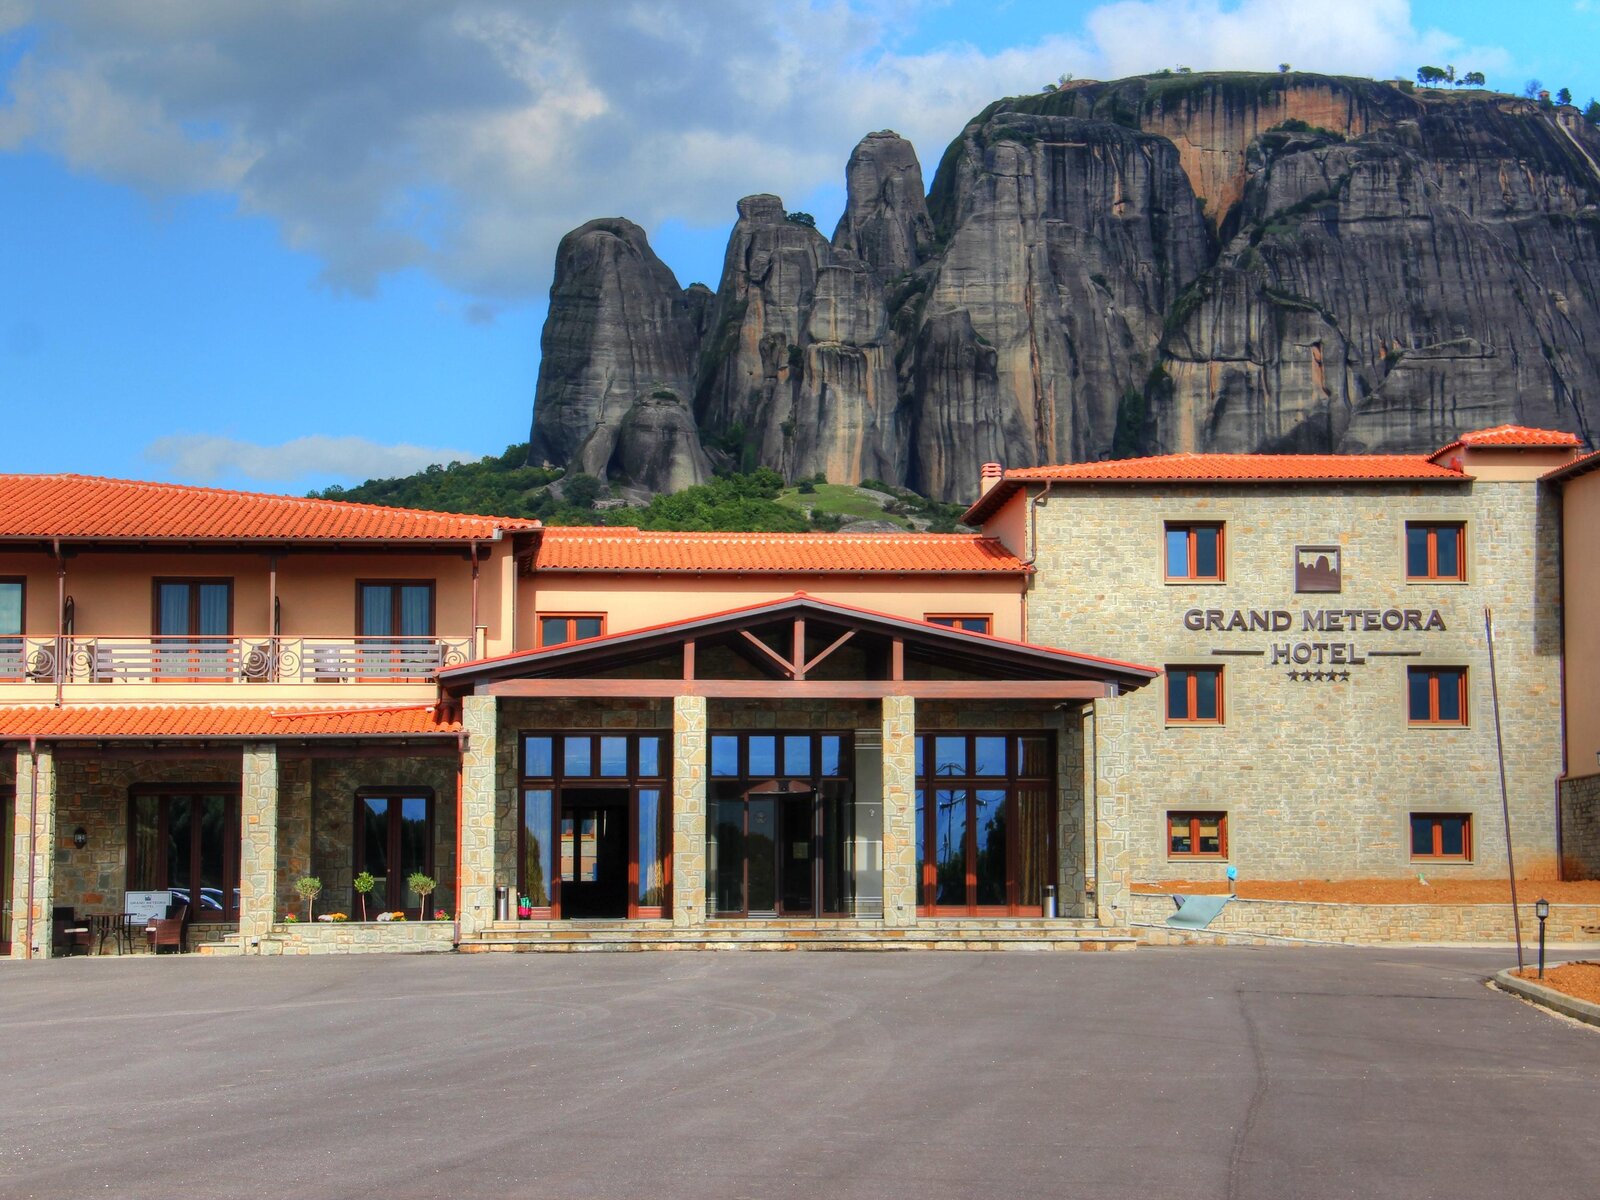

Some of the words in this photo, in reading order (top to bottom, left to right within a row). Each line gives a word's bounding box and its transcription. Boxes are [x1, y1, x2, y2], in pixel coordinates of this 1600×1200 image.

[1183, 608, 1293, 632] GRAND
[1301, 608, 1447, 632] METEORA
[1270, 642, 1366, 665] HOTEL
